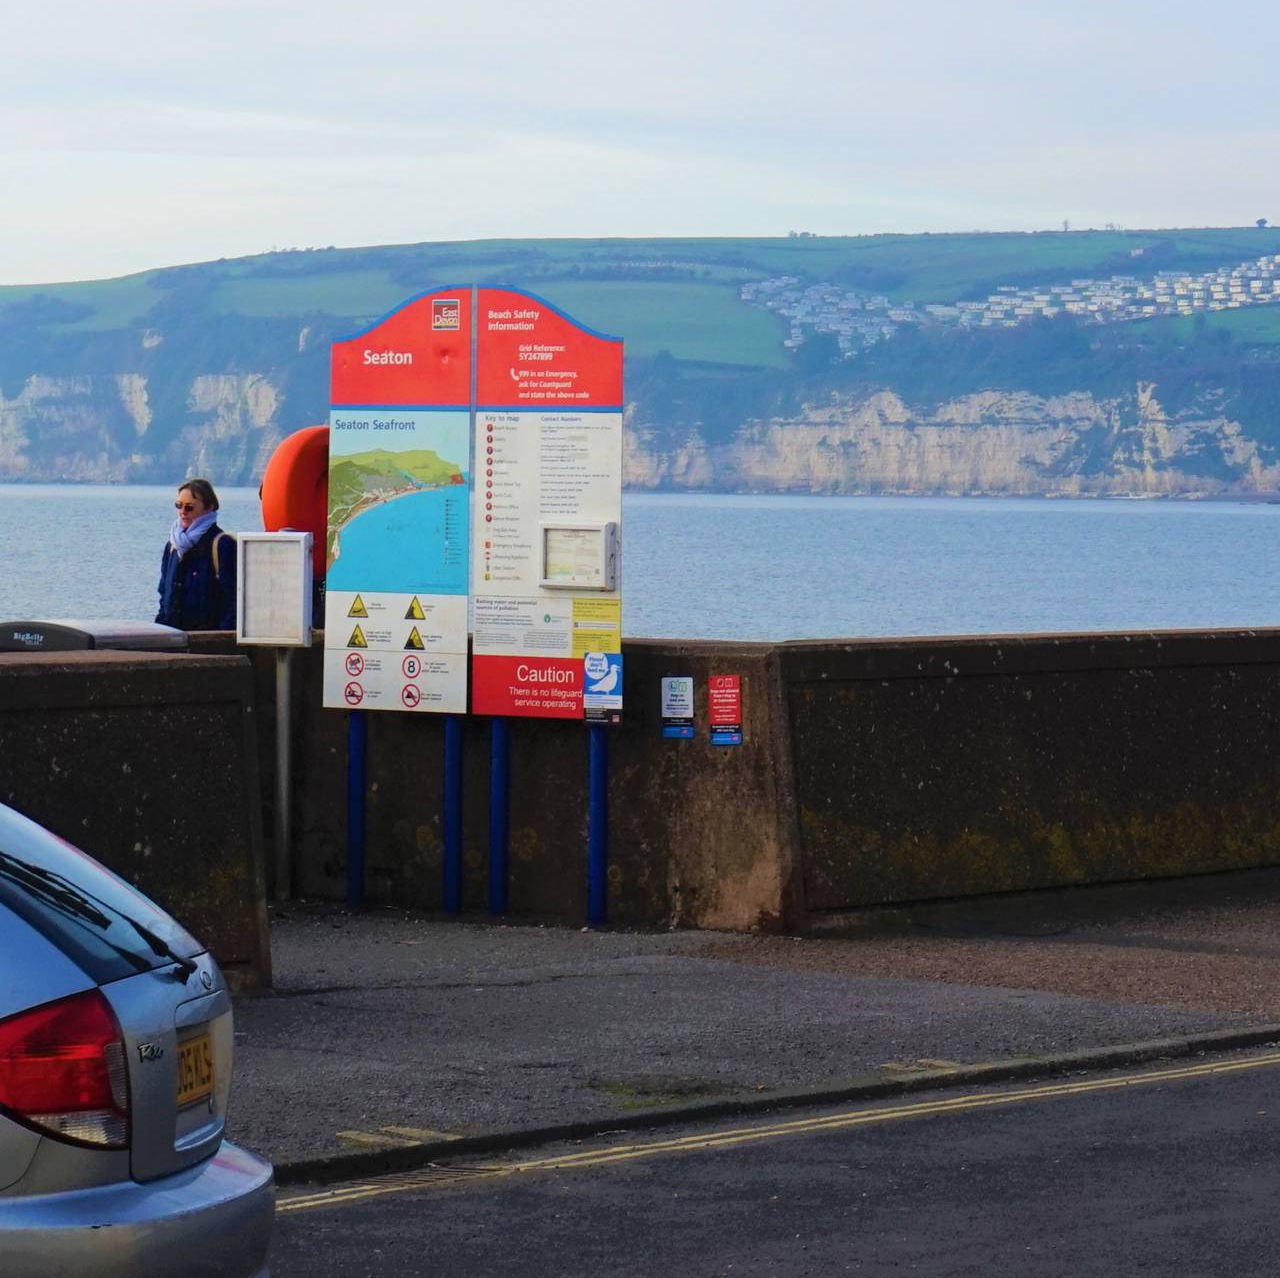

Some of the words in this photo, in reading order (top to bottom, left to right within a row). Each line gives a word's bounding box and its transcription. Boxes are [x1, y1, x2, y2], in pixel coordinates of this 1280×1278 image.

[442, 307, 458, 317] East
[488, 310, 511, 319] Beach
[513, 310, 540, 321] Safety
[434, 315, 458, 324] Devon
[488, 321, 535, 331] Information
[518, 344, 532, 352] Grid
[363, 349, 413, 366] Seaton
[335, 419, 369, 430] Seaton
[373, 419, 416, 430] Seafront
[407, 660, 415, 673] 8
[517, 664, 574, 683] Caution
[509, 686, 530, 696] There
[532, 688, 538, 696] is
[551, 688, 582, 699] lifeguard
[515, 698, 540, 707] service
[542, 700, 576, 710] operating
